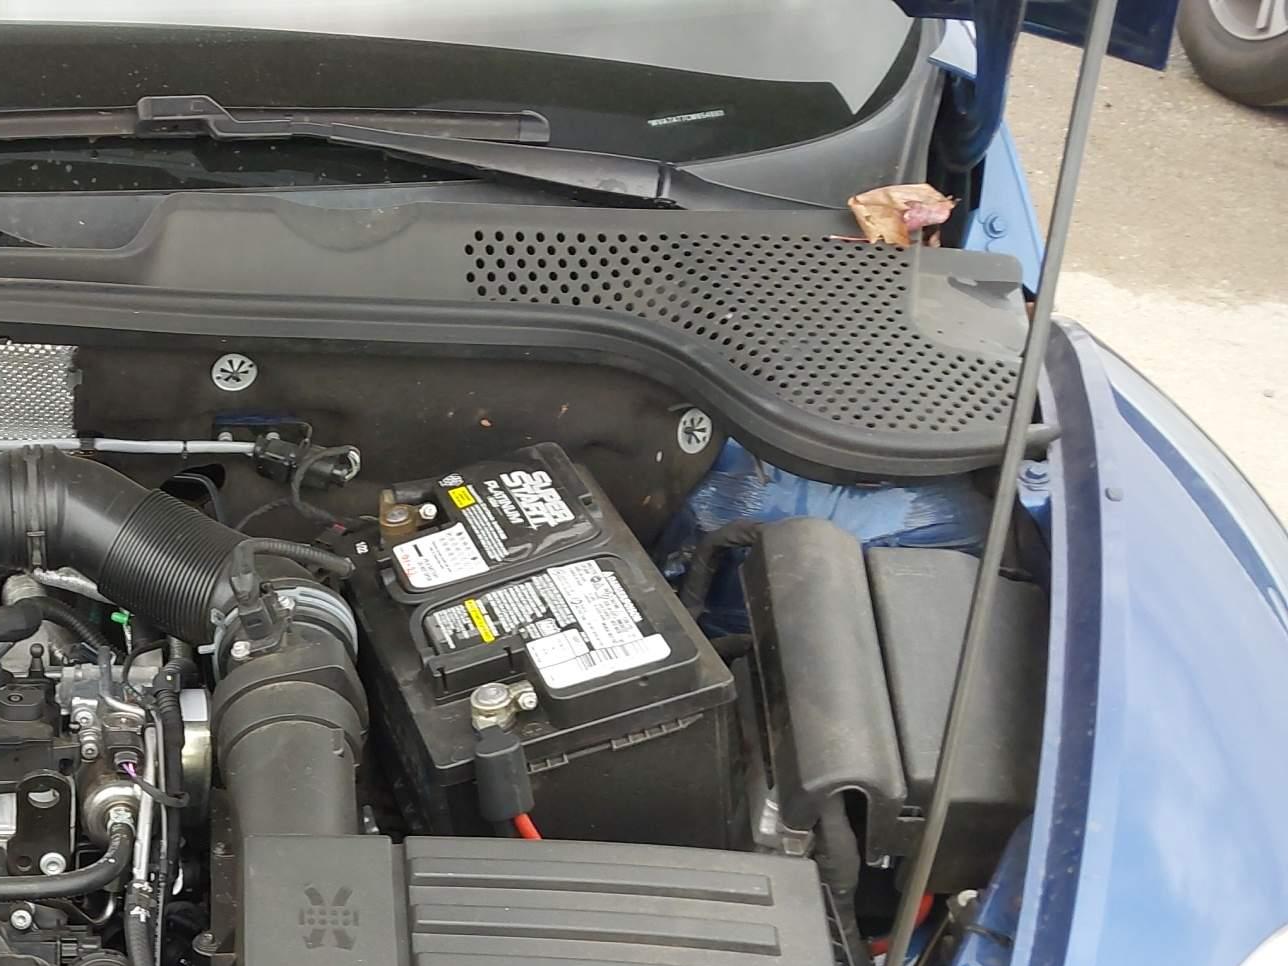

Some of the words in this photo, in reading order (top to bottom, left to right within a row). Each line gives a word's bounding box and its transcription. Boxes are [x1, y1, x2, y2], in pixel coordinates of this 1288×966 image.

[484, 480, 525, 526] PLATINUM
[500, 470, 554, 530] START
[528, 470, 576, 526] SUPER
